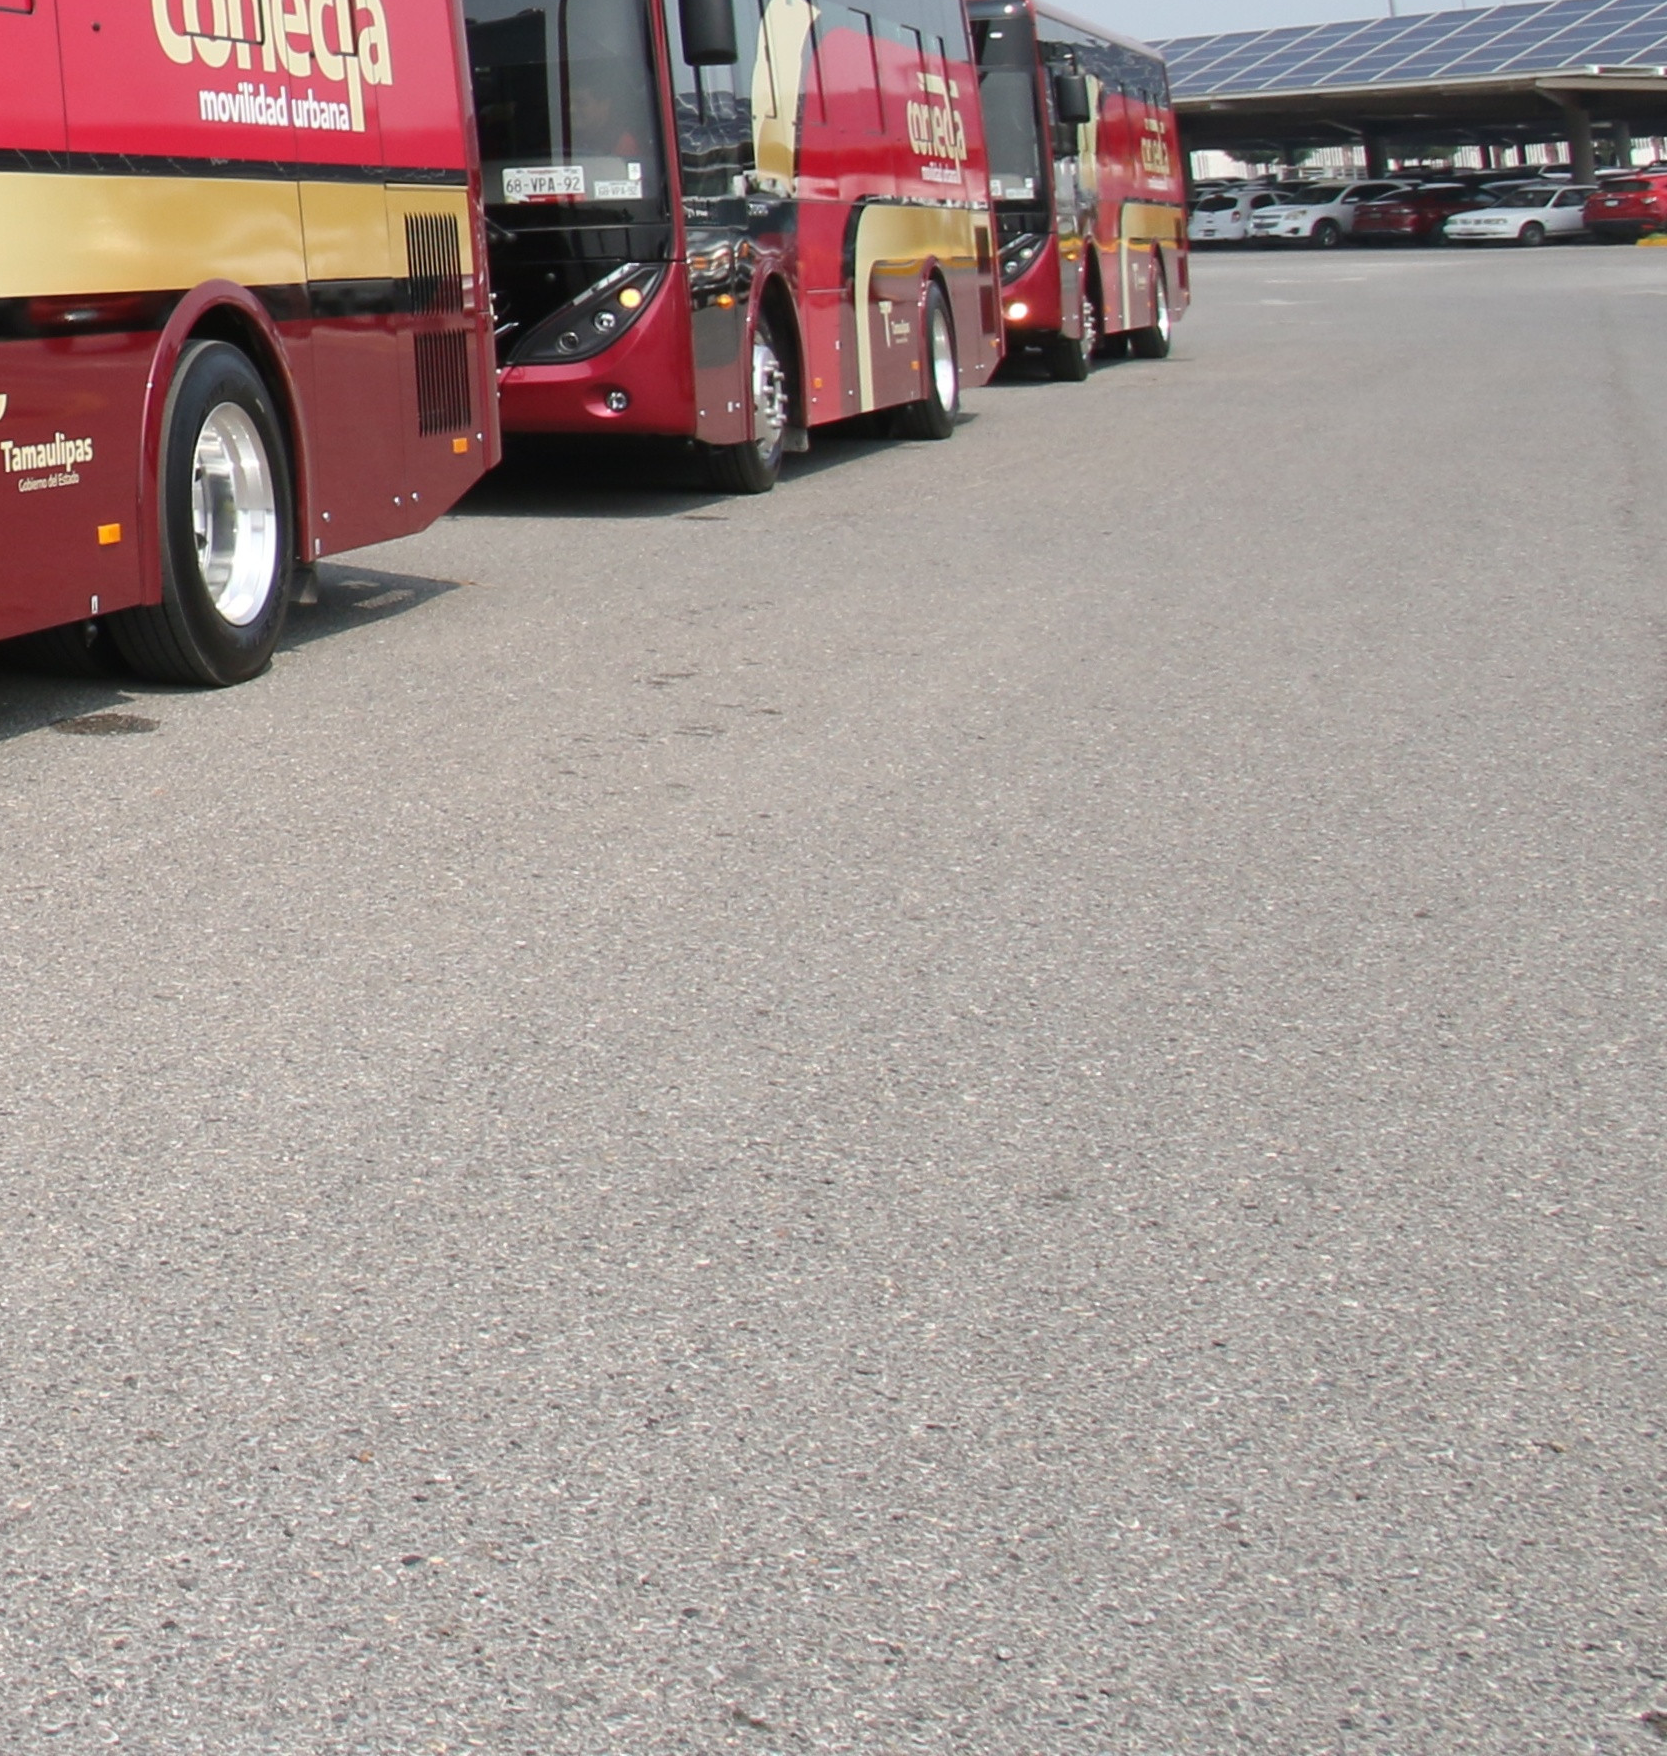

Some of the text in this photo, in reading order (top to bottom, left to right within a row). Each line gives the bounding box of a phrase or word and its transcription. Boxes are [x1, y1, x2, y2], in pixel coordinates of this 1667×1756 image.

[198, 81, 350, 131] movilidad urbana
[506, 176, 582, 193] 68-VPA-92
[0, 431, 94, 473] Tamaulipas
